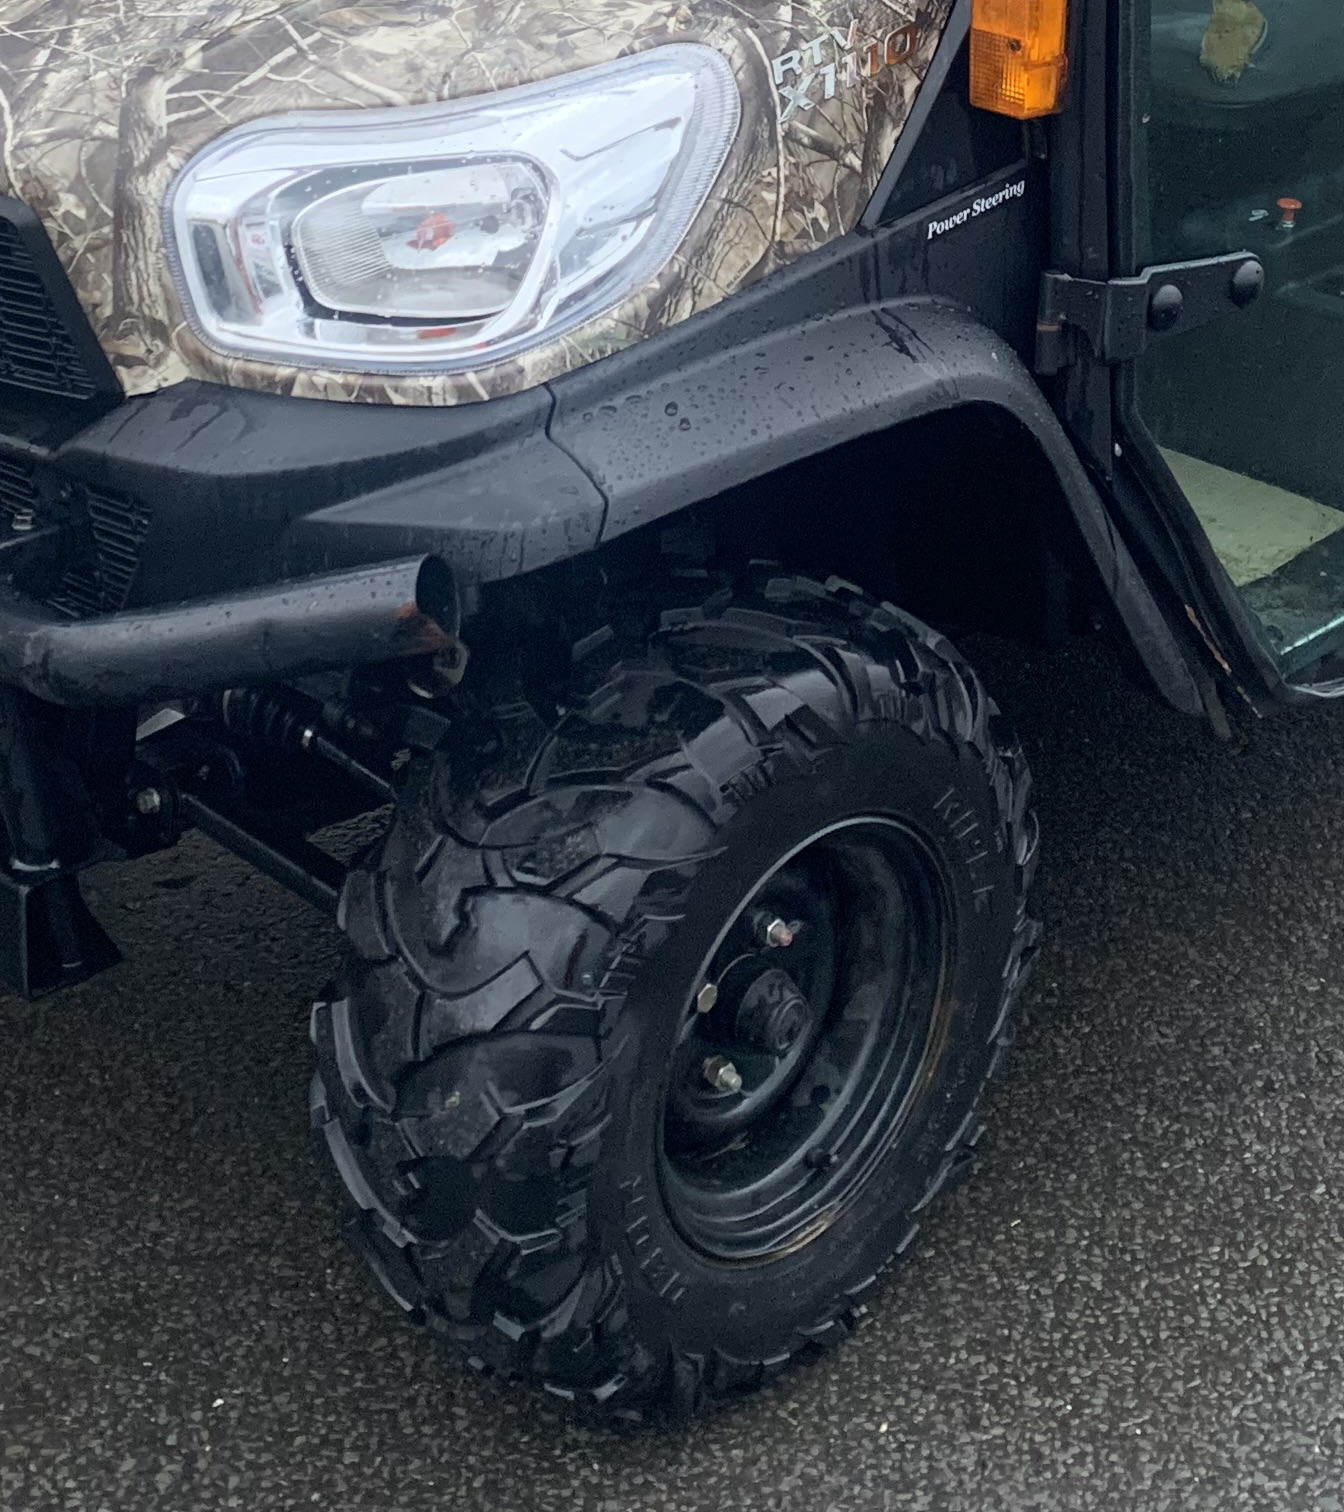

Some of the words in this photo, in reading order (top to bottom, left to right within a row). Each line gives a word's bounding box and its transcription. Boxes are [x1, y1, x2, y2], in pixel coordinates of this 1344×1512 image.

[771, 19, 859, 86] RTV
[778, 22, 921, 124] X1110
[927, 208, 971, 240] Power
[971, 180, 1025, 217] Steering
